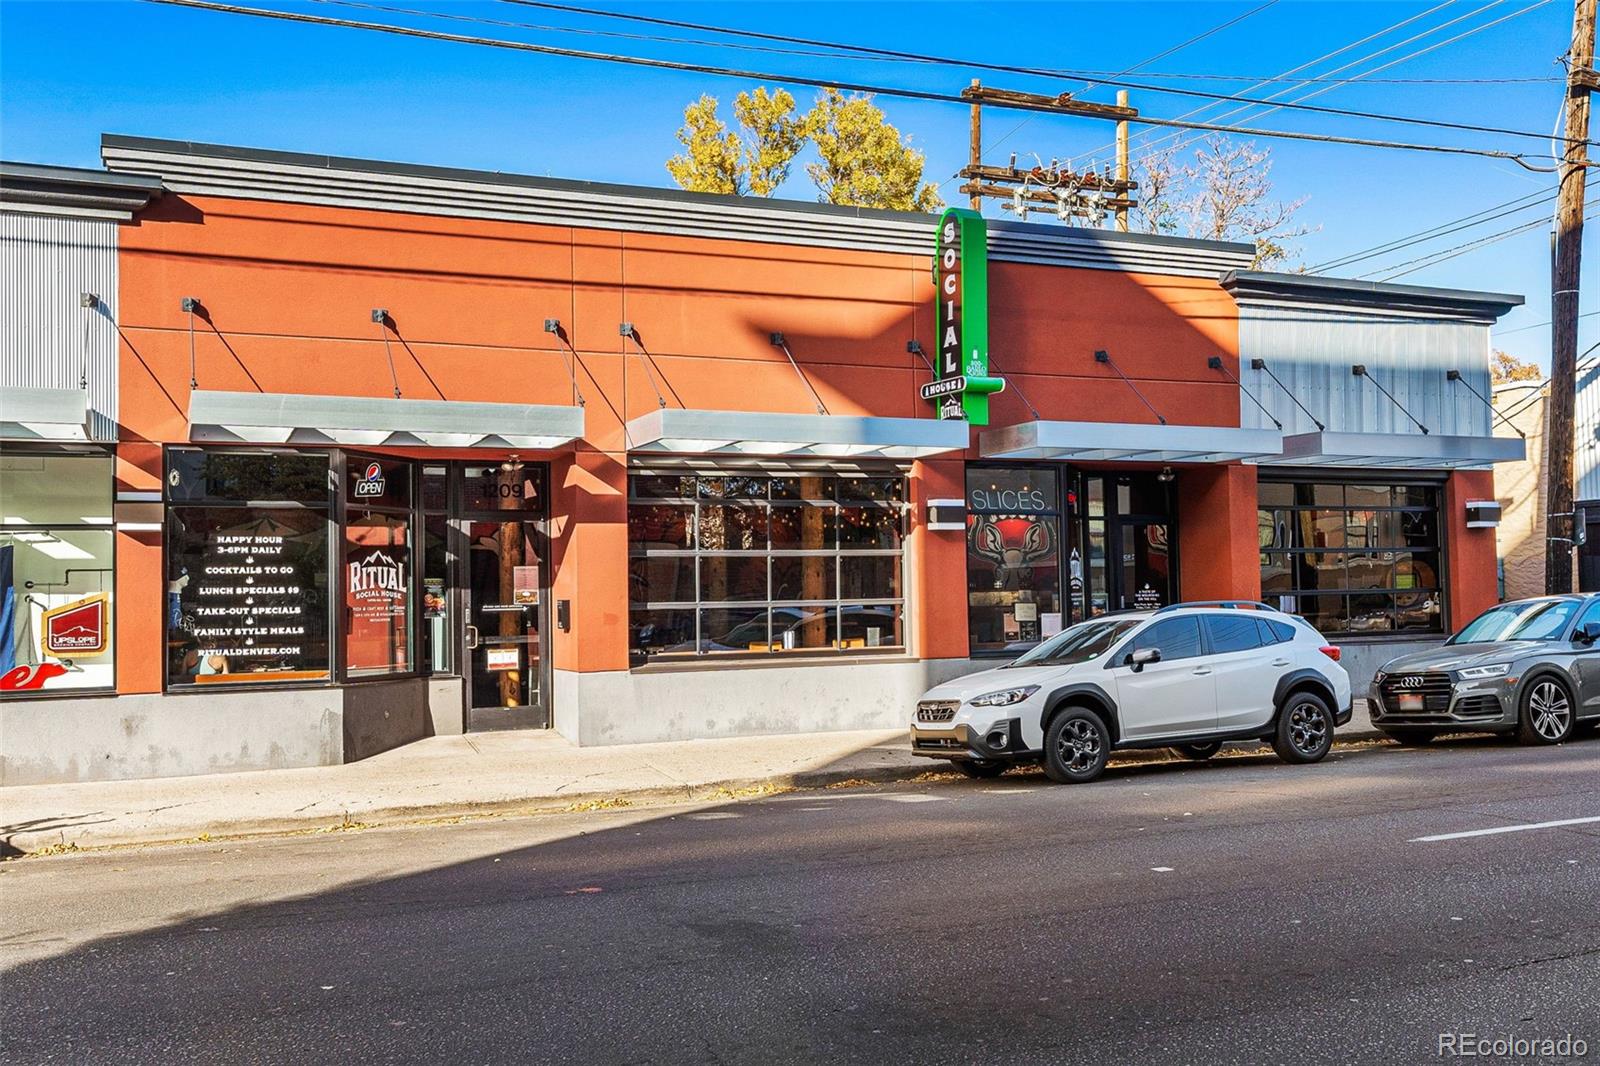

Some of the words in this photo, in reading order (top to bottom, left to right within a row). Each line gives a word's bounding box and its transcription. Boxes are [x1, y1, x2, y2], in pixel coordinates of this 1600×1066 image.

[943, 222, 958, 374] SOCIAL
[929, 380, 957, 395] HOUSE
[359, 482, 382, 494] OPEN
[972, 489, 1045, 511] SLICES
[217, 536, 253, 544] HAPPY
[255, 536, 283, 544] HOUR
[217, 546, 249, 554] 3-6PM
[251, 546, 282, 554] DAILY
[205, 566, 262, 574] COCKTAILS
[264, 566, 278, 574] TO
[279, 566, 294, 574] GO
[350, 561, 407, 593] RITUAL
[199, 587, 234, 595] LUNCH
[235, 586, 286, 594] SPECIALS
[287, 586, 300, 594] $9
[355, 590, 379, 599] SOCIAL
[380, 590, 402, 599] HOUSE
[193, 628, 232, 636] FAMILY
[234, 627, 268, 635] STYLE
[53, 636, 97, 644] UPSLOPE
[197, 647, 301, 656] RITUALDENVER.COM
